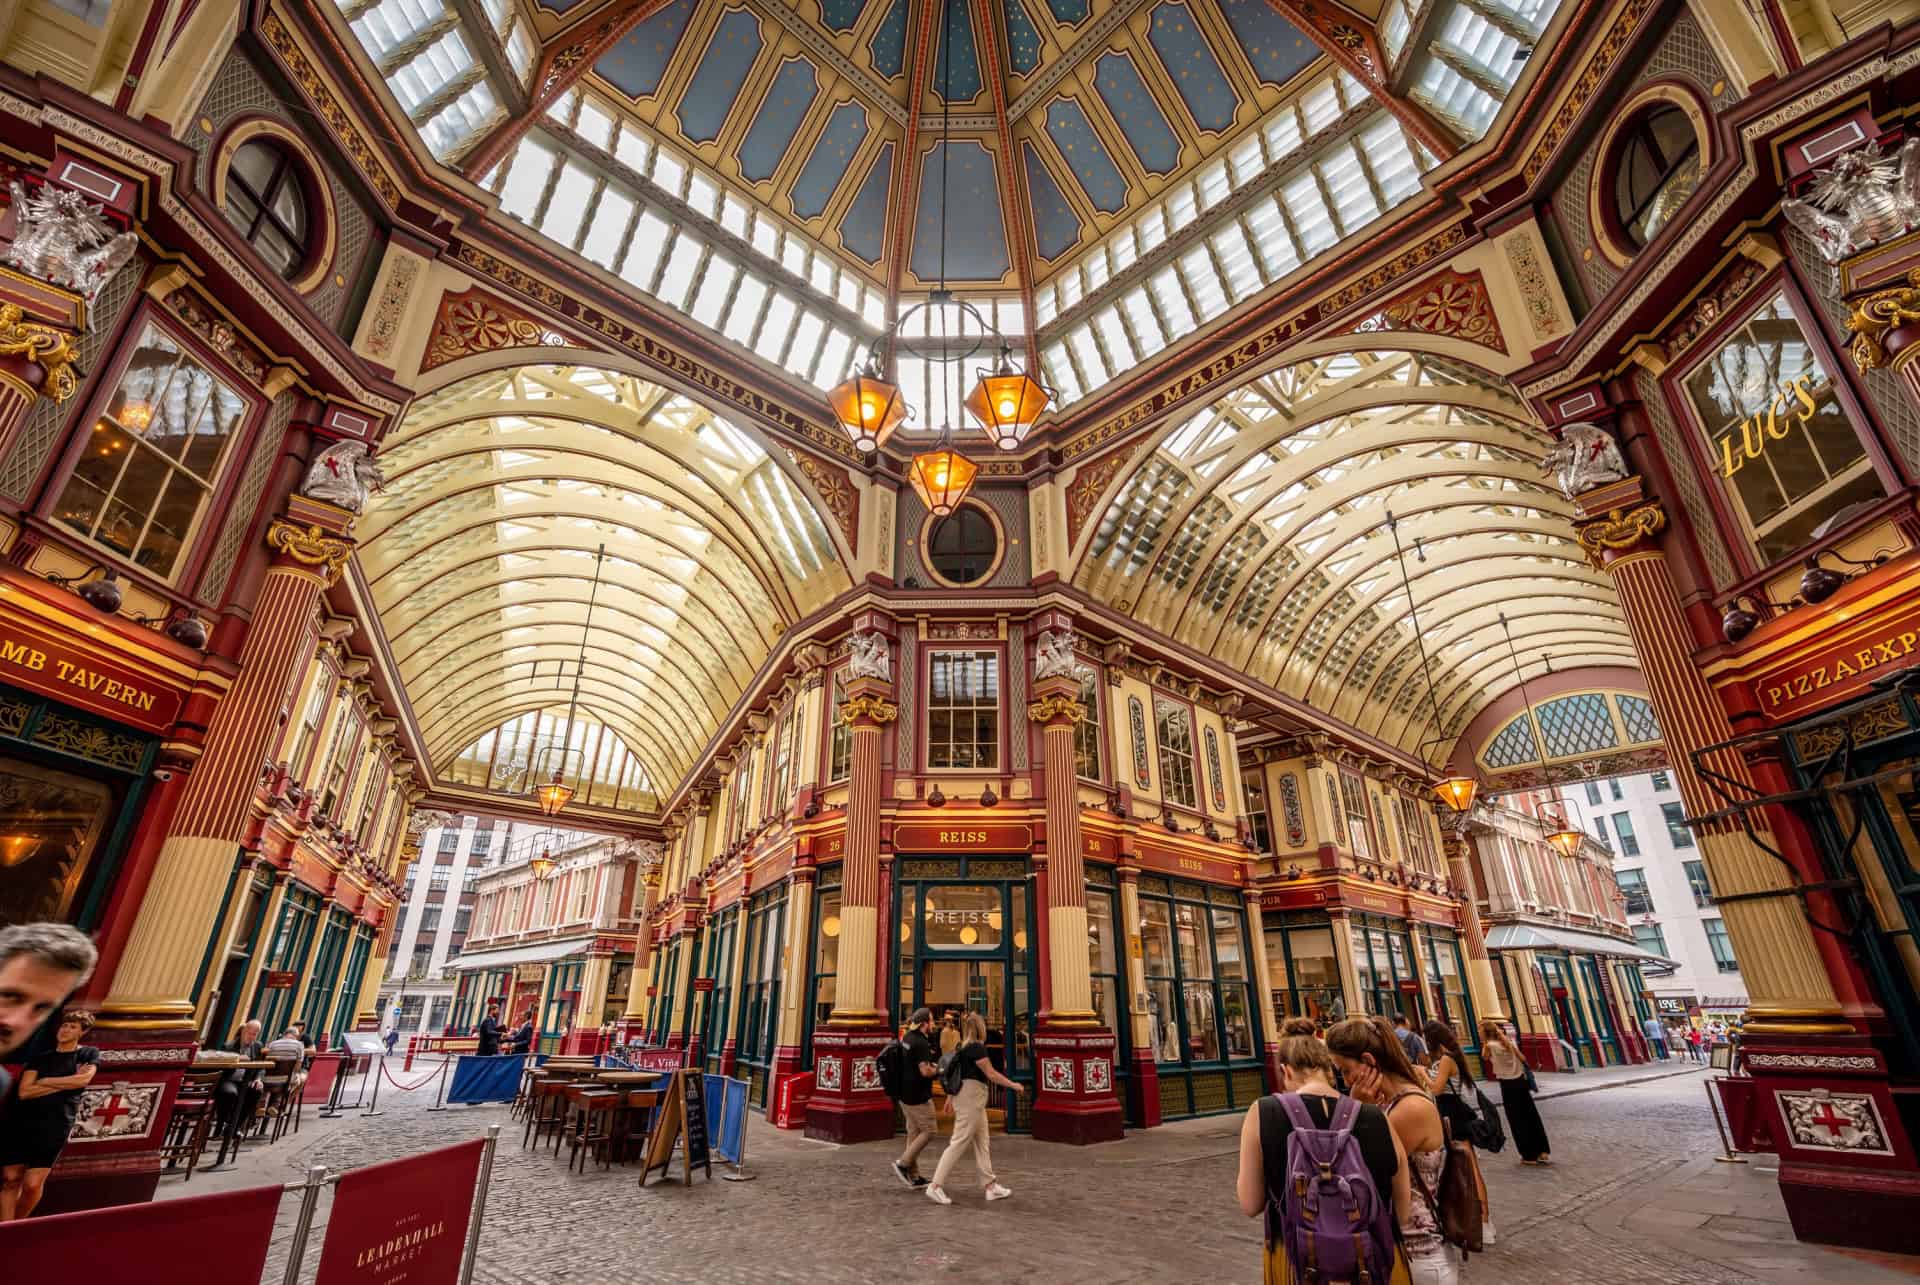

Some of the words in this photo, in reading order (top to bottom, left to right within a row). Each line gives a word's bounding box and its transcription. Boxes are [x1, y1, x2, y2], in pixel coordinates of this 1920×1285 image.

[575, 303, 797, 434] LEADENHALL
[1162, 313, 1308, 406] MARKET
[1720, 374, 1816, 478] LUC'S
[56, 660, 157, 711] TAVERN
[1767, 627, 1920, 706] PIZZAEXP
[939, 831, 988, 843] REISS
[935, 911, 992, 925] REISS
[643, 1058, 655, 1068] La
[356, 1220, 445, 1268] LEADENHALL
[373, 1245, 423, 1275] MARKET
